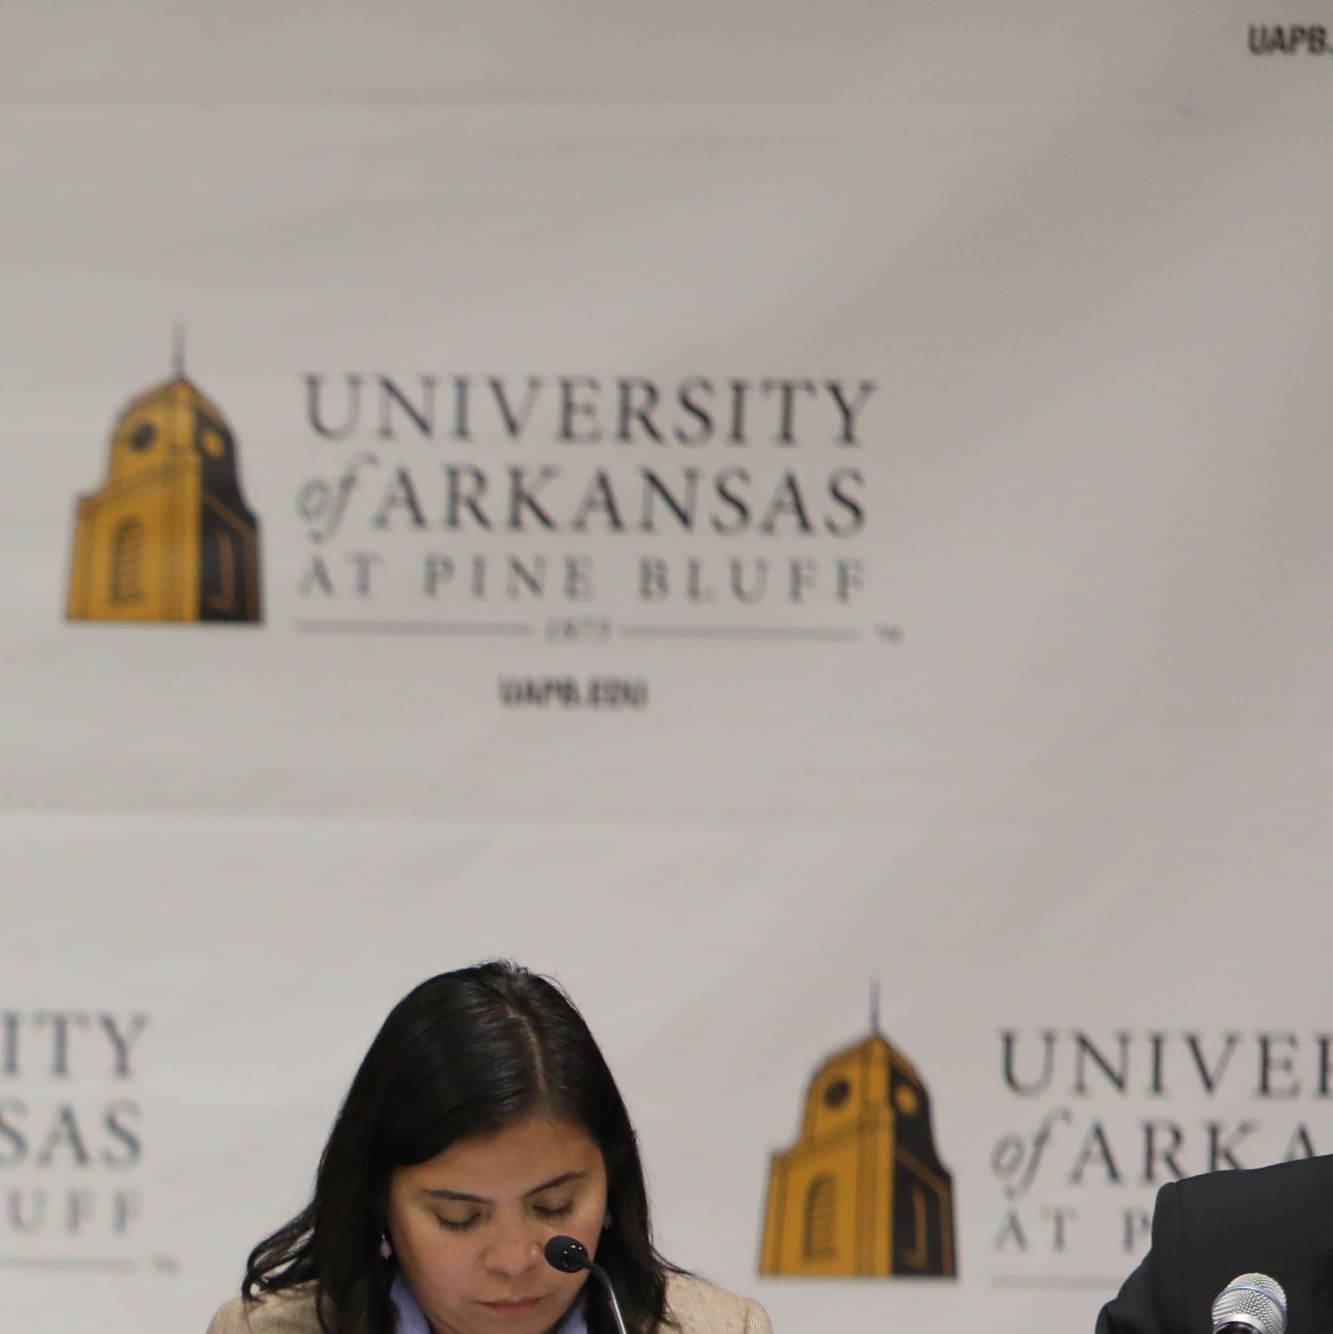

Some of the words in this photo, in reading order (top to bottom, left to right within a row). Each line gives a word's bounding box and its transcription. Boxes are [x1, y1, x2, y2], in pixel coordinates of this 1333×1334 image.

[301, 372, 879, 449] UNIVERSITY
[296, 453, 378, 545] of
[371, 464, 869, 540] ARKANSAS
[297, 552, 381, 598] AT
[422, 553, 595, 602] PINE
[639, 556, 867, 604] BLUFF
[991, 1106, 1071, 1200] of
[995, 1206, 1078, 1252] AT
